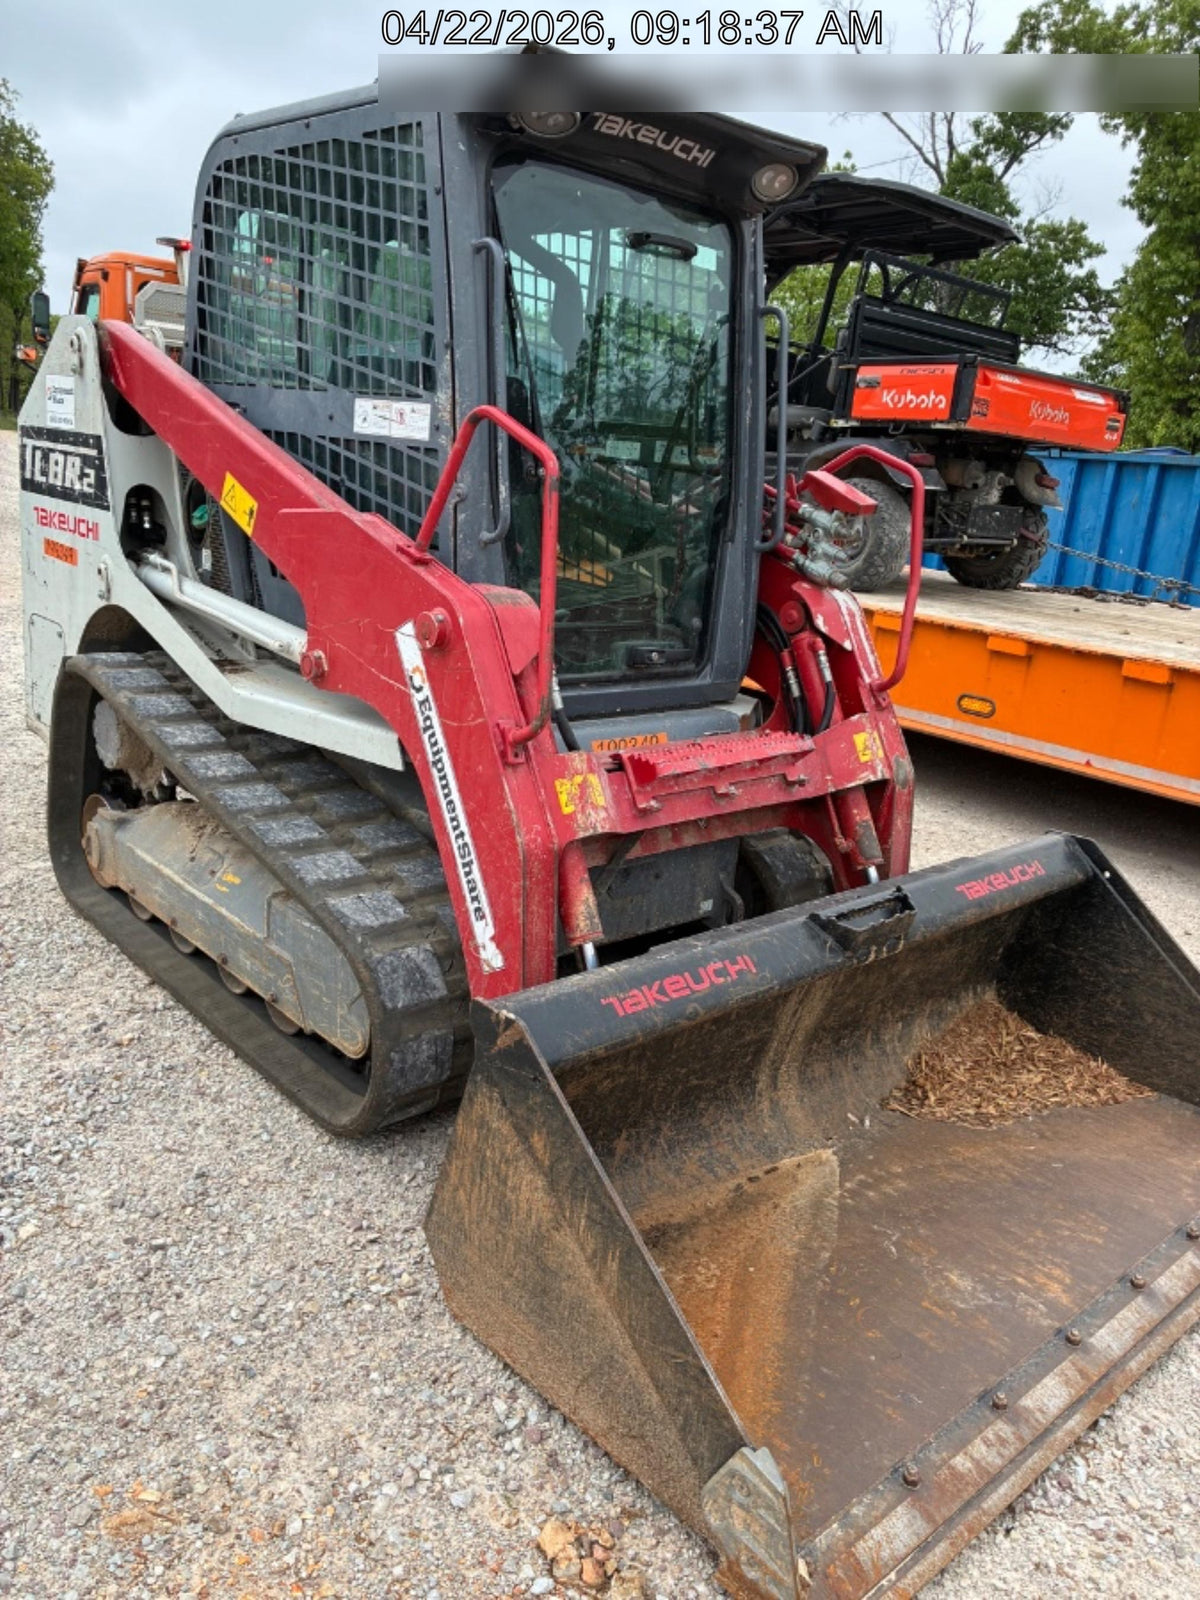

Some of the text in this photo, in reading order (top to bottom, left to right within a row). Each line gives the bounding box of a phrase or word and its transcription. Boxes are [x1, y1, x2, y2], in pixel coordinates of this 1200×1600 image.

[881, 389, 947, 409] Kubota
[1029, 399, 1070, 425] Kubota
[417, 697, 487, 923] EquipmentShare
